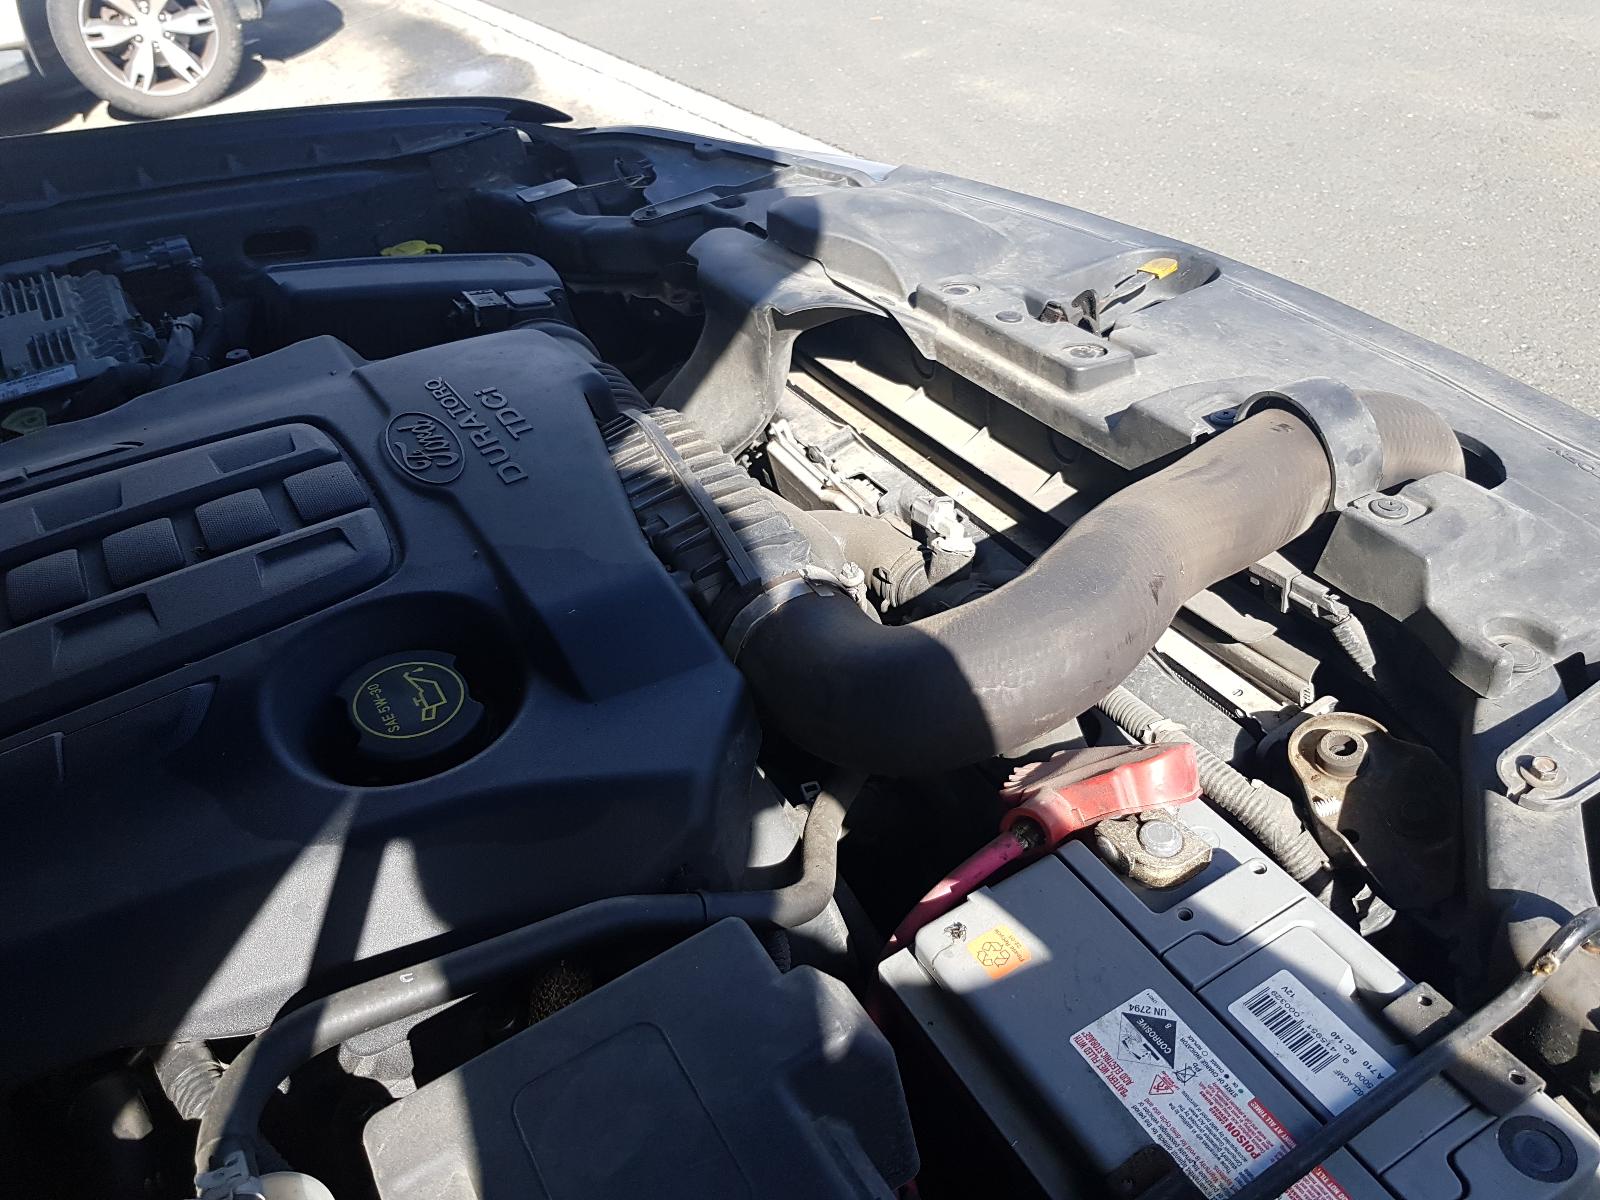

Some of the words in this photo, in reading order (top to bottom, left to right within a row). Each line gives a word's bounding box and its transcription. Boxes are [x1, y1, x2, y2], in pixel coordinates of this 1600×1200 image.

[366, 682, 390, 714] 5W-30
[380, 712, 400, 733] SAE
[1280, 983, 1297, 999] 12V
[1129, 1004, 1150, 1013] 2794
[1153, 1007, 1166, 1016] UN
[1163, 1021, 1172, 1030] 8
[1072, 1033, 1087, 1049] WITH
[1135, 1016, 1172, 1055] CORROSIVE
[1329, 1029, 1345, 1045] 140
[1082, 1045, 1101, 1064] FILLED
[1179, 1036, 1202, 1061] INDICATOR
[1342, 1041, 1357, 1056] RC
[1100, 1050, 1123, 1075] ELECTRIC
[1190, 1061, 1202, 1073] Pb
[1201, 1060, 1219, 1078] CHARGE
[1360, 1058, 1379, 1076] 710
[1118, 1070, 1134, 1087] ACID
[1215, 1075, 1225, 1085] OF
[1222, 1083, 1238, 1098] STATE
[1130, 1102, 1147, 1120] period
[1143, 1118, 1152, 1127] the
[1150, 1126, 1159, 1135] for
[1223, 1120, 1261, 1160] POISON
[1326, 1180, 1341, 1195] NOT
